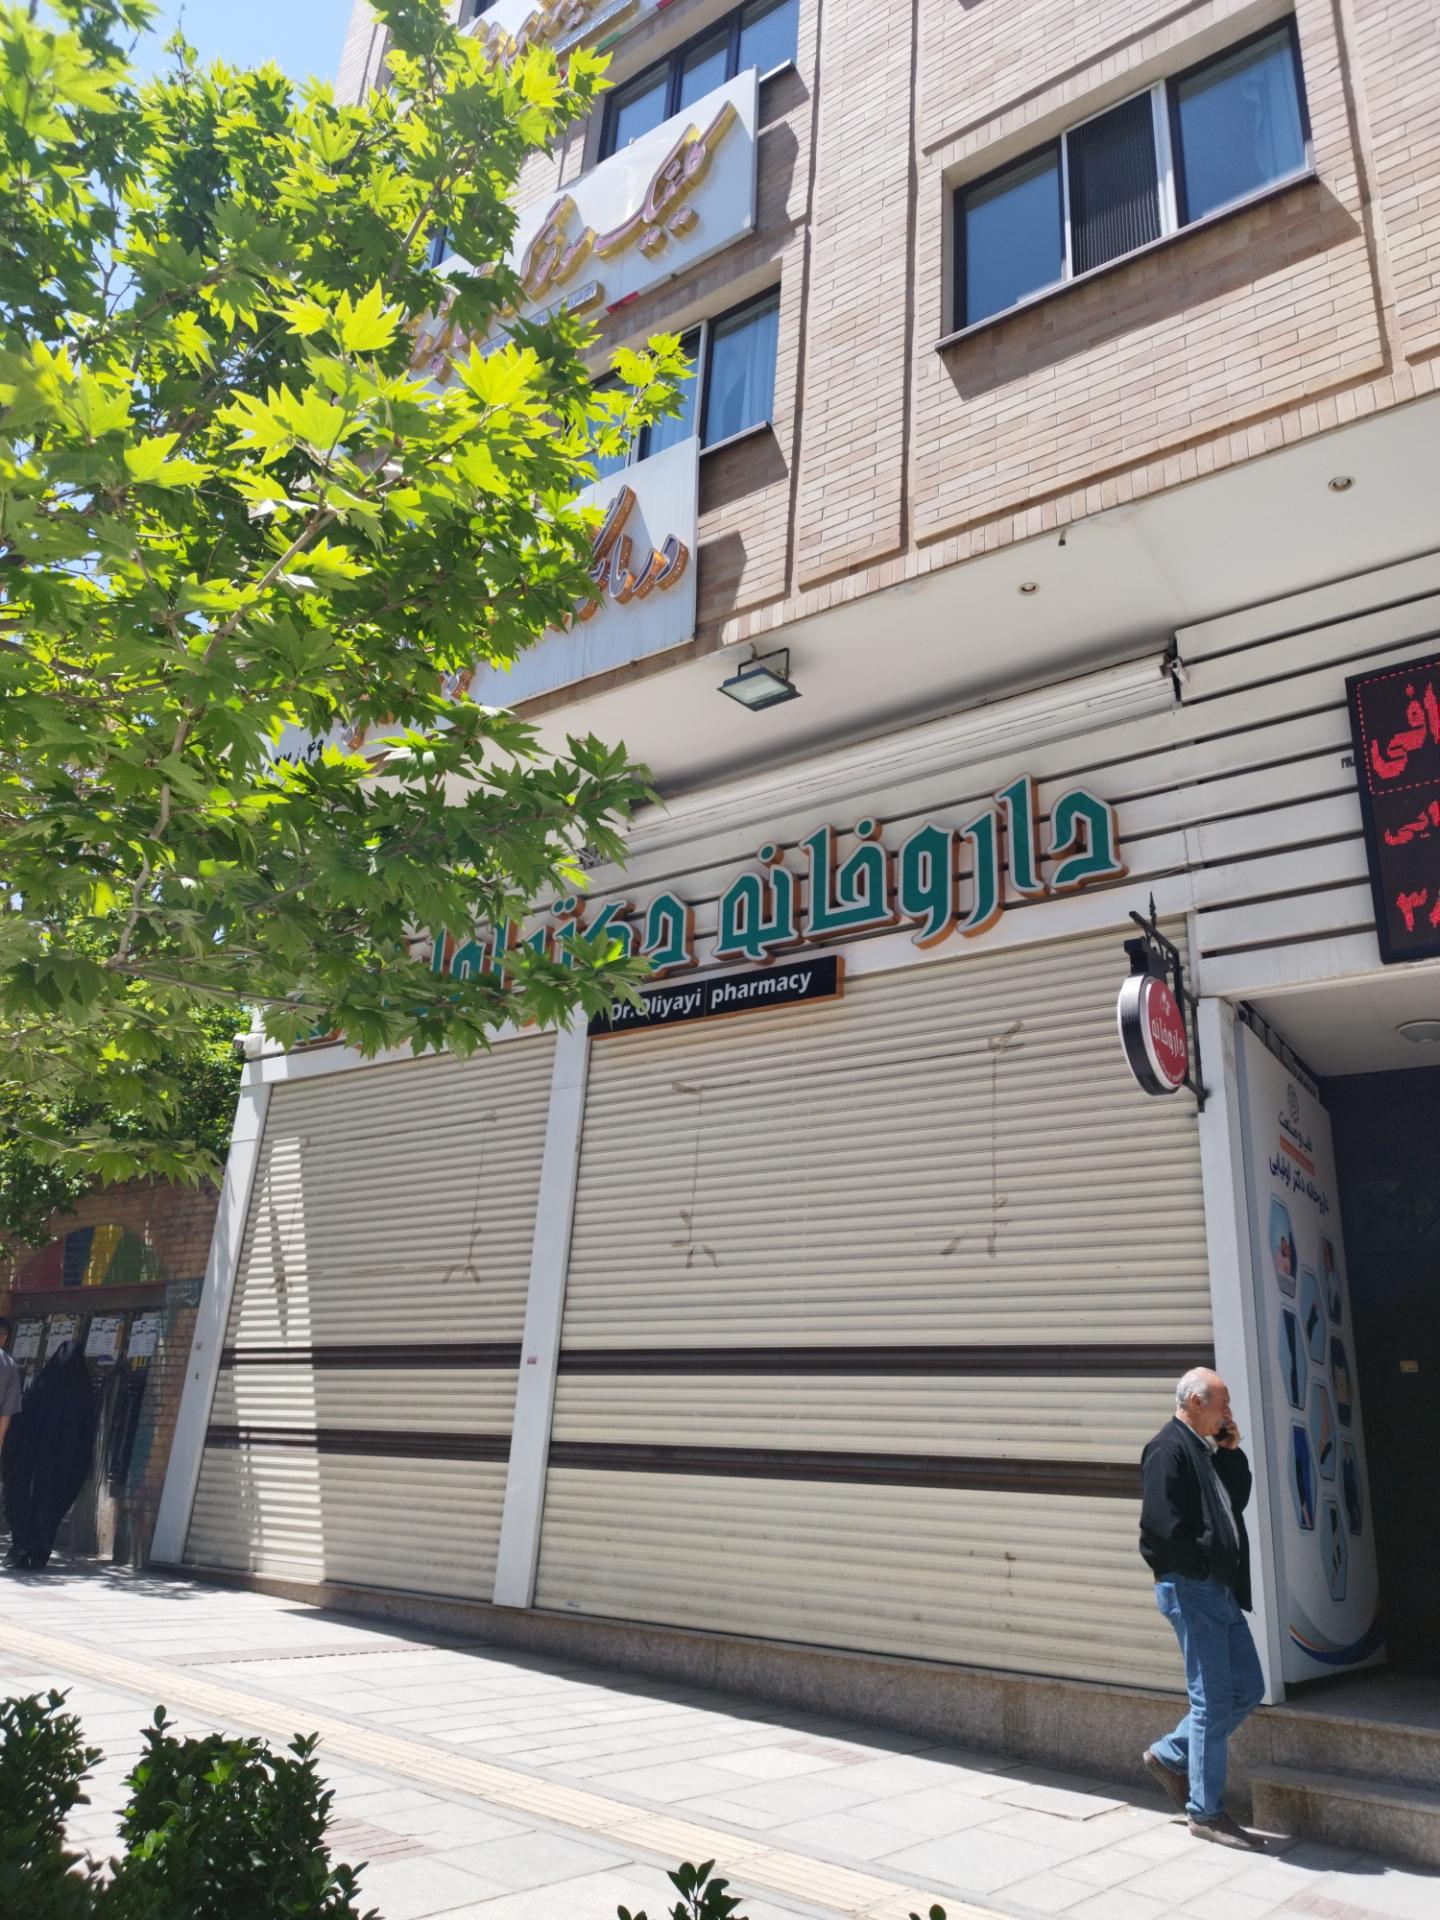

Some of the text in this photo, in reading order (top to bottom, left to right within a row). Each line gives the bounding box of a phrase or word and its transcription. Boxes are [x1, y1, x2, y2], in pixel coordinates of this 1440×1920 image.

[711, 772, 1126, 962] داروخانه
[710, 970, 812, 1009] pharmacy
[1151, 1017, 1186, 1058] داروخانه
